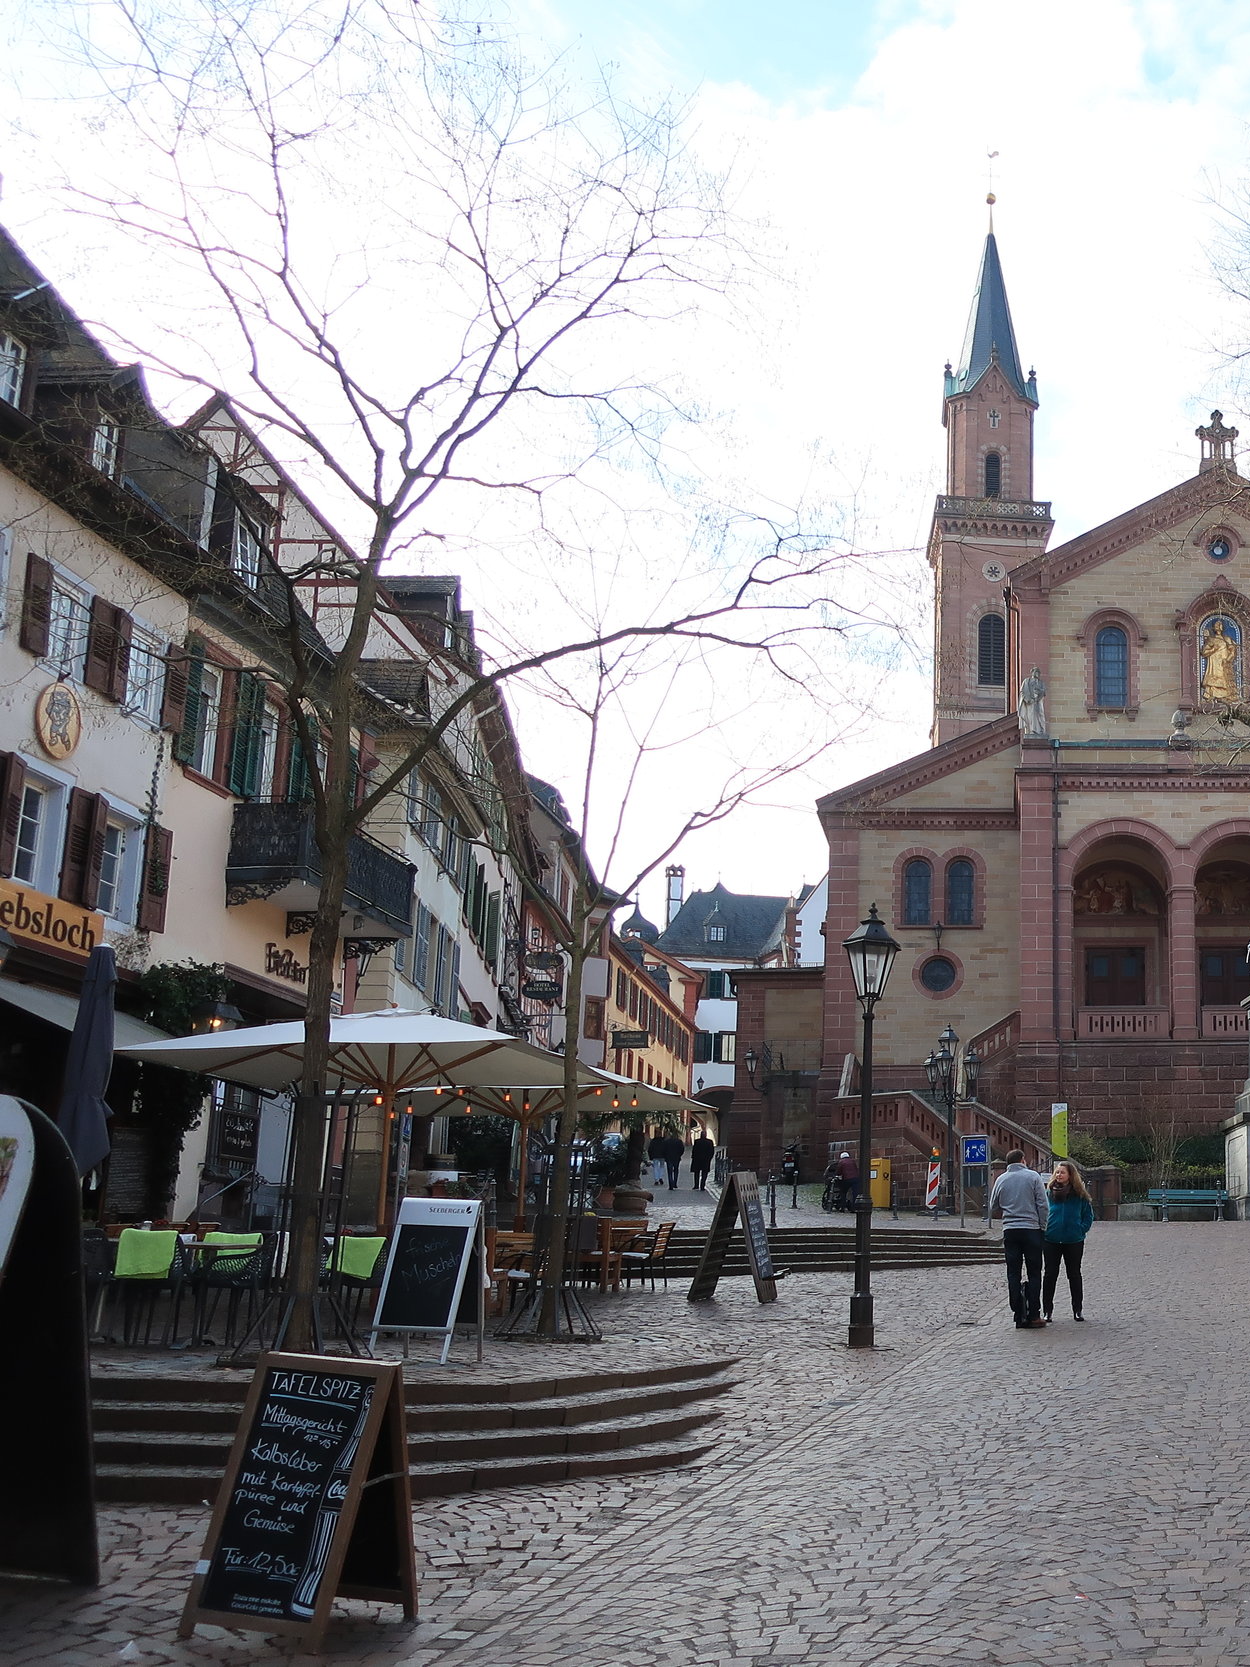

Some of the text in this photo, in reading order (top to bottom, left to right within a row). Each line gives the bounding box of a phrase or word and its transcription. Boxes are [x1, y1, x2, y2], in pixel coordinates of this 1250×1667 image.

[429, 1206, 465, 1214] SEEBERGER
[272, 1371, 361, 1400] TAFELSPITZ
[262, 1403, 348, 1435] Mittagsgericht
[251, 1438, 322, 1473] Kalbsleber
[241, 1470, 321, 1498] mit Kartoffel-
[243, 1509, 297, 1534] Gemüse
[280, 1501, 309, 1515] und
